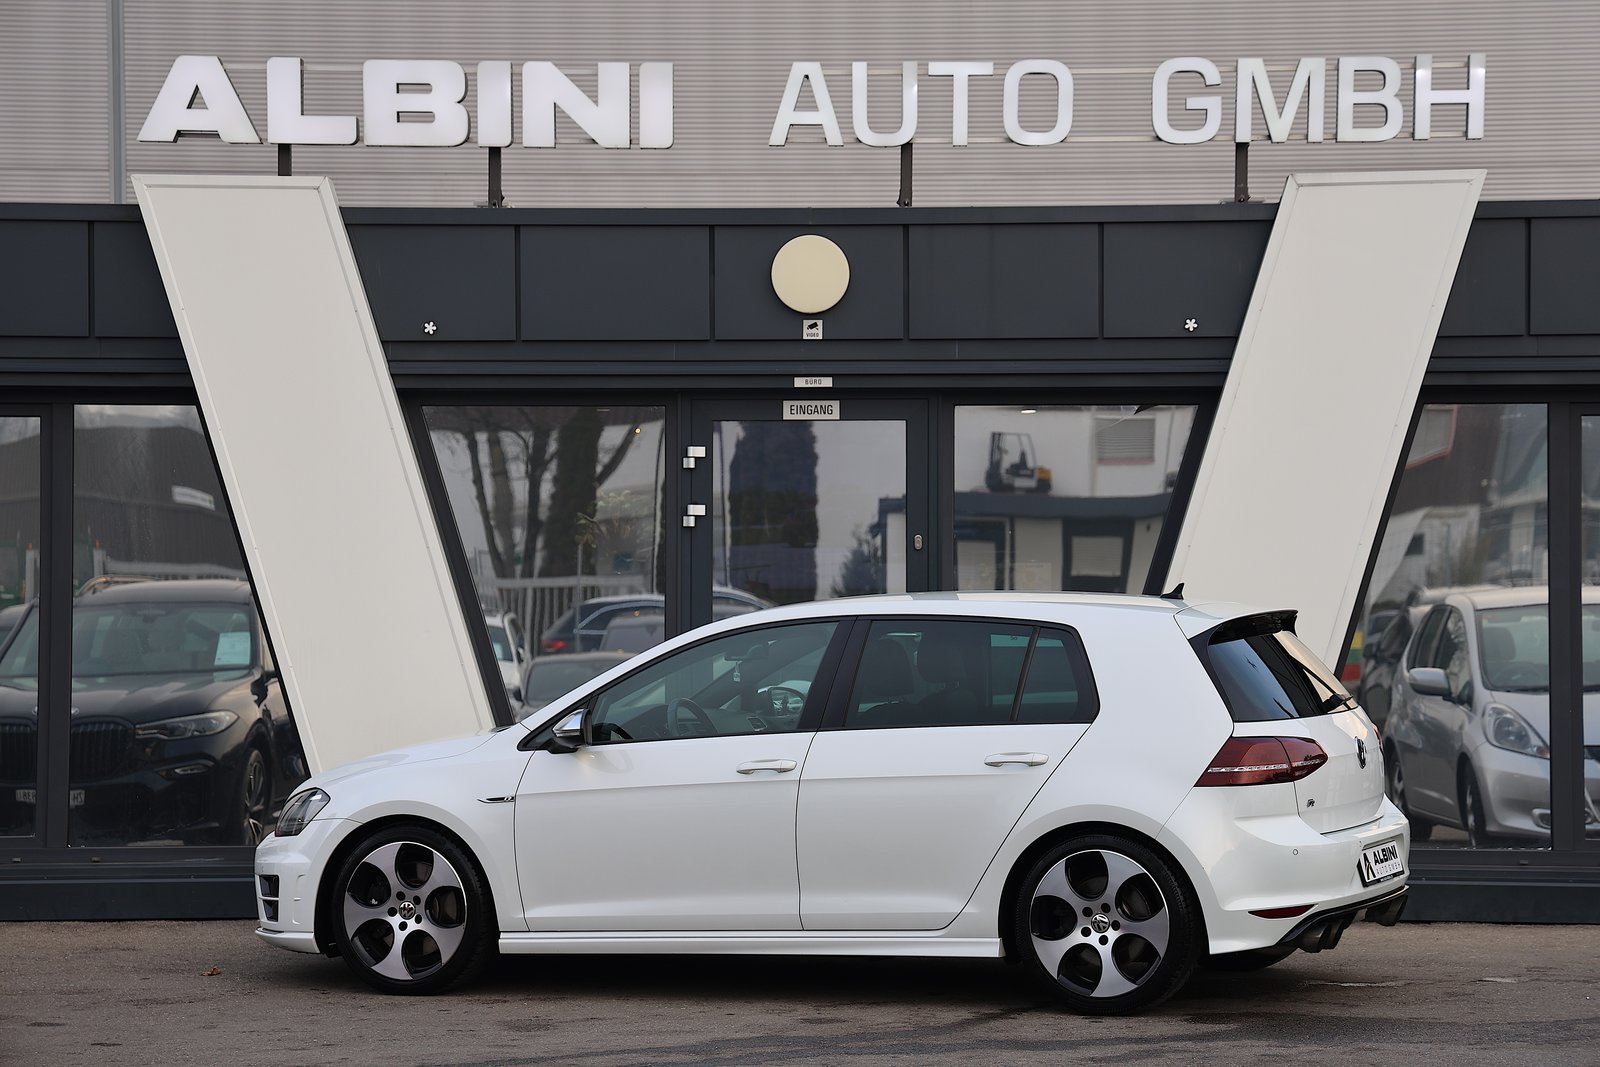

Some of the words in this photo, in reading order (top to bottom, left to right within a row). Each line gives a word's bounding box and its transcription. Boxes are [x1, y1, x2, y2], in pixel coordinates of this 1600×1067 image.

[137, 55, 674, 149] ALBINI
[769, 58, 1074, 148] AUTO
[1151, 54, 1487, 144] GMBH
[790, 404, 833, 416] EINGANG
[1373, 845, 1398, 865] ALBINI
